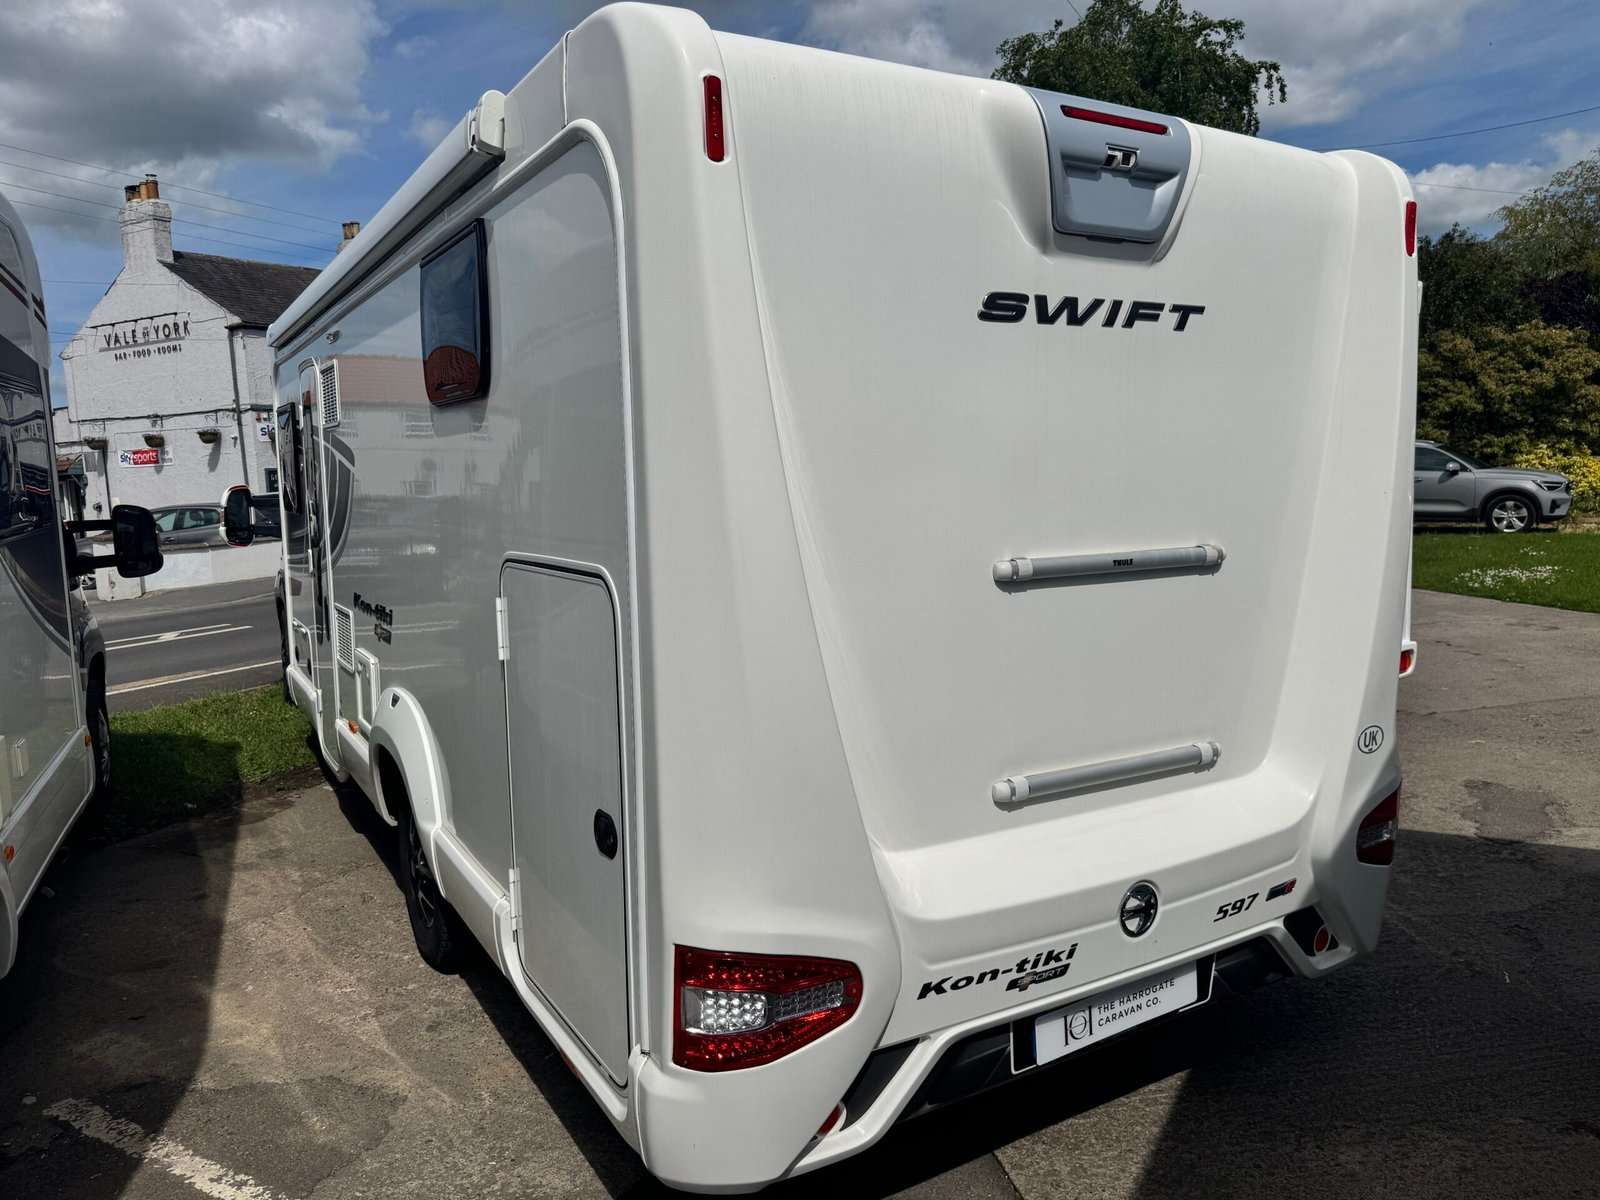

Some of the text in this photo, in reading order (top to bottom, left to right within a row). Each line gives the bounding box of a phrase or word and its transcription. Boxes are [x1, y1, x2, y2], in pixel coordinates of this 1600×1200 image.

[977, 291, 1206, 332] SWIFT
[103, 328, 138, 347] VALE
[152, 320, 191, 340] YORK
[114, 343, 182, 362] BAR FOOD ROOMS
[120, 452, 131, 465] sky
[133, 451, 158, 465] sports
[1112, 558, 1134, 567] THULE
[353, 591, 393, 627] Kon-tiki
[1363, 729, 1379, 748] UK
[1213, 892, 1260, 923] 597
[916, 942, 1079, 1001] Kon-tiki
[1016, 966, 1065, 987] SPORT
[1097, 978, 1176, 1015] THE HARROGATE
[1097, 1004, 1143, 1027] CARAVAN
[1145, 996, 1162, 1009] CO.
